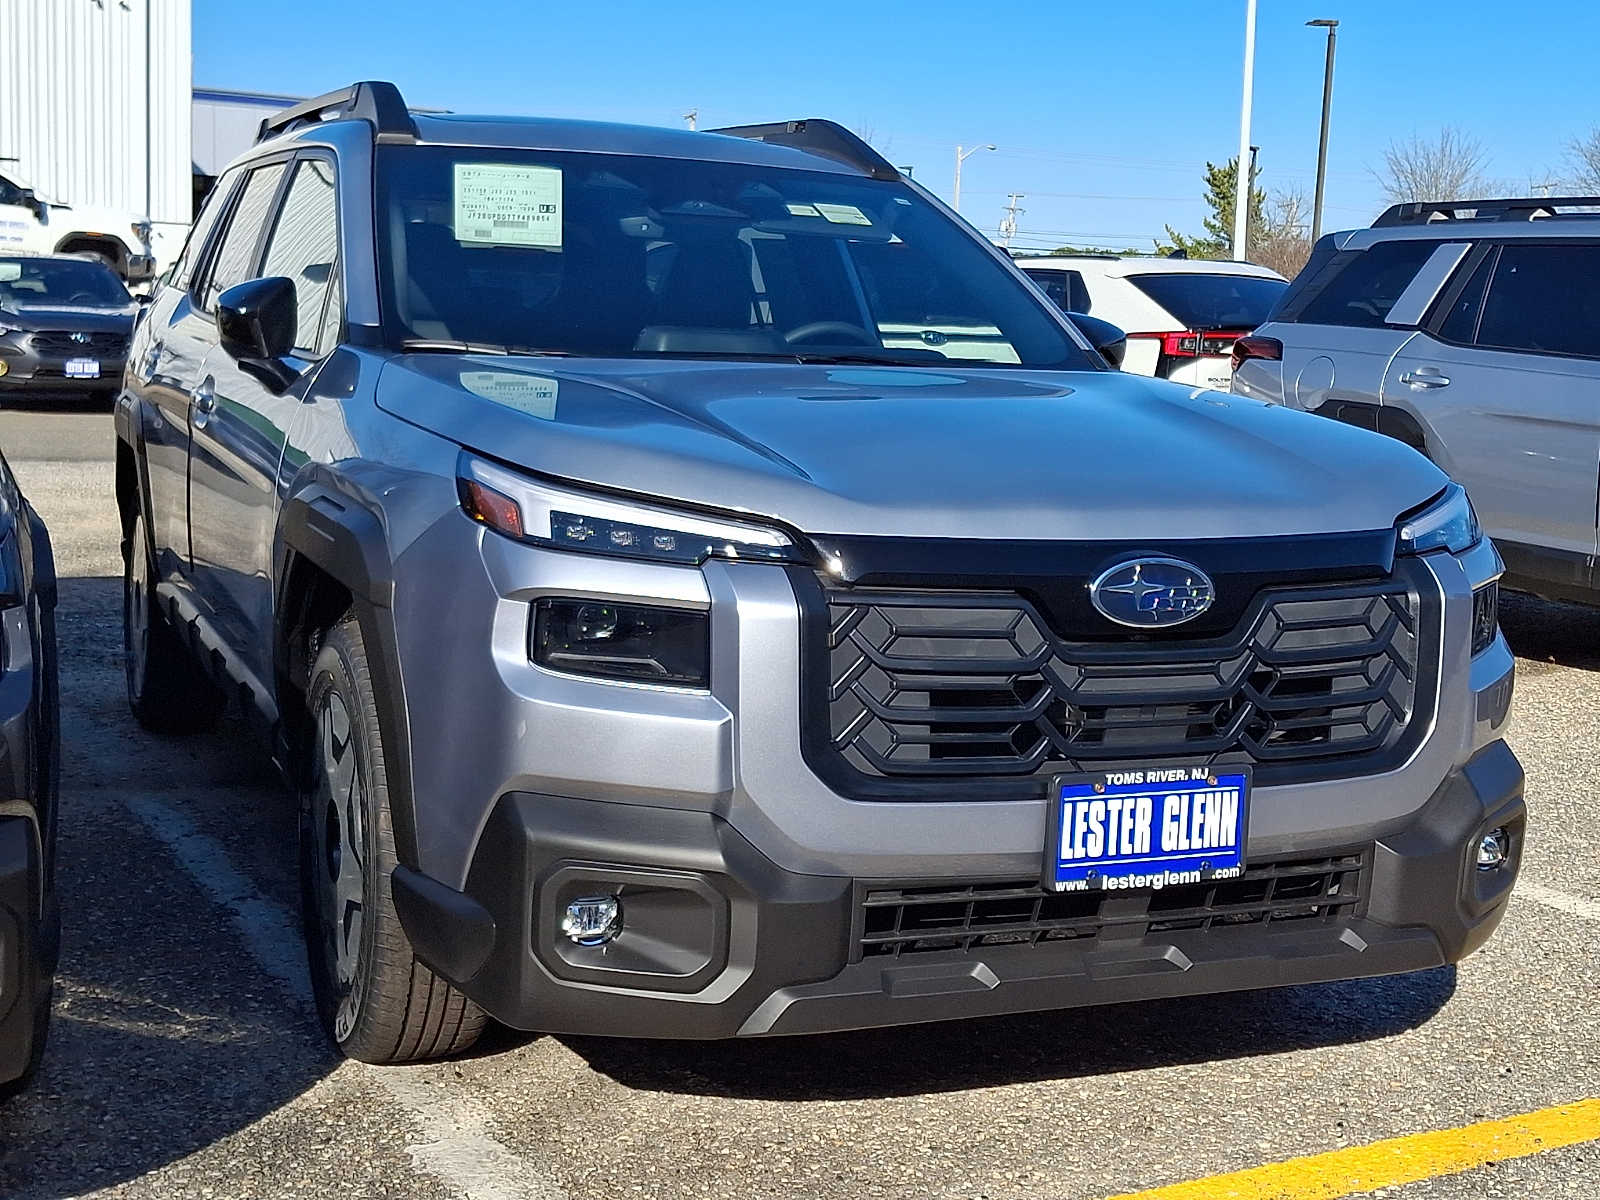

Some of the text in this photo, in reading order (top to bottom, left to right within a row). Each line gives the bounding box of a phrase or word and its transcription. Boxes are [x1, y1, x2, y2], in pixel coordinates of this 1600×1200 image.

[1106, 772, 1144, 785] TOMS
[1191, 767, 1209, 780] NJ
[1060, 790, 1239, 860] LESTER GLENN
[1102, 870, 1200, 890] lesterglenn
